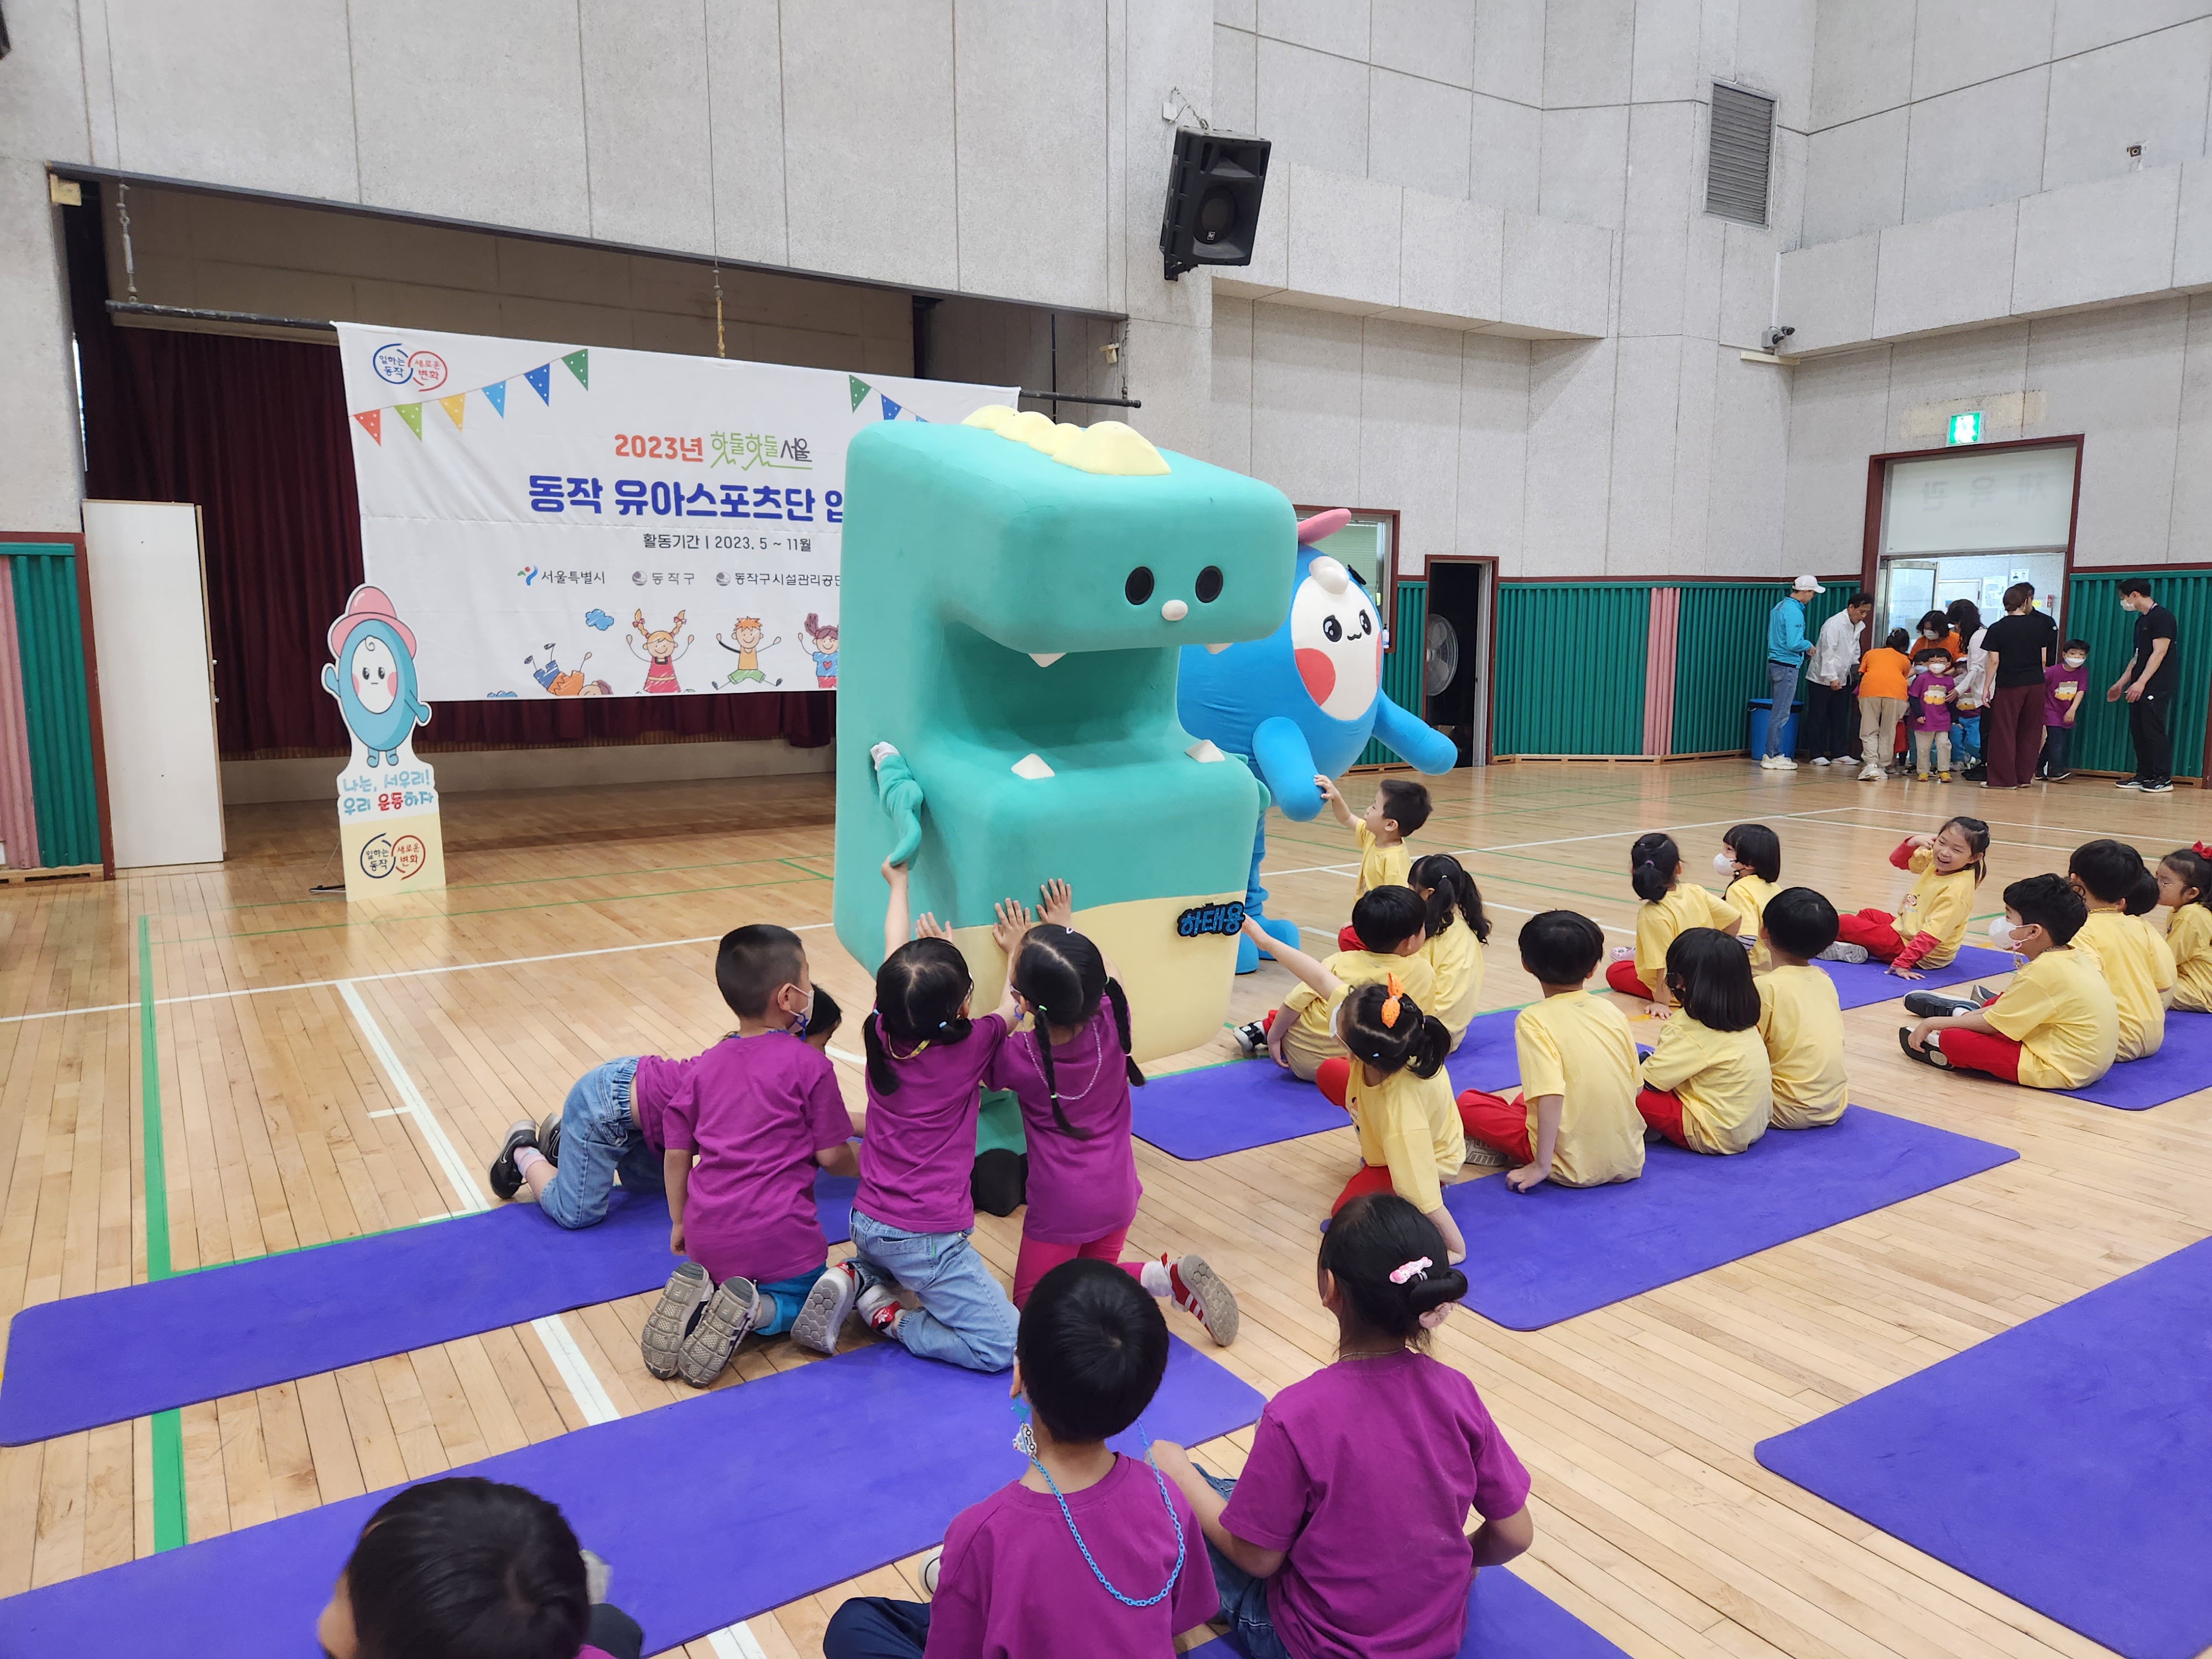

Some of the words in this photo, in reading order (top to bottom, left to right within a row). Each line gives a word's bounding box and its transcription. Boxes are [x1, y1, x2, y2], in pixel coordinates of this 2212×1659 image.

[379, 356, 405, 367] 일하는
[415, 359, 441, 370] 새로운
[384, 366, 404, 378] 동작
[419, 369, 439, 380] 변화
[615, 434, 703, 462] 2023년
[529, 476, 603, 514] 동작
[615, 479, 816, 521] 유아스포츠단
[643, 533, 700, 549] 활동기간
[715, 536, 754, 549] 2023.
[760, 538, 767, 549] 5
[787, 538, 811, 552] 11월
[541, 570, 605, 584] 서울특별시
[343, 775, 377, 792] 나는,
[343, 797, 371, 816] 우리
[378, 791, 434, 811] 운동하자
[366, 848, 389, 860] 일하는
[398, 843, 420, 854] 새로운
[369, 859, 388, 872] 동작
[400, 854, 418, 867] 변화
